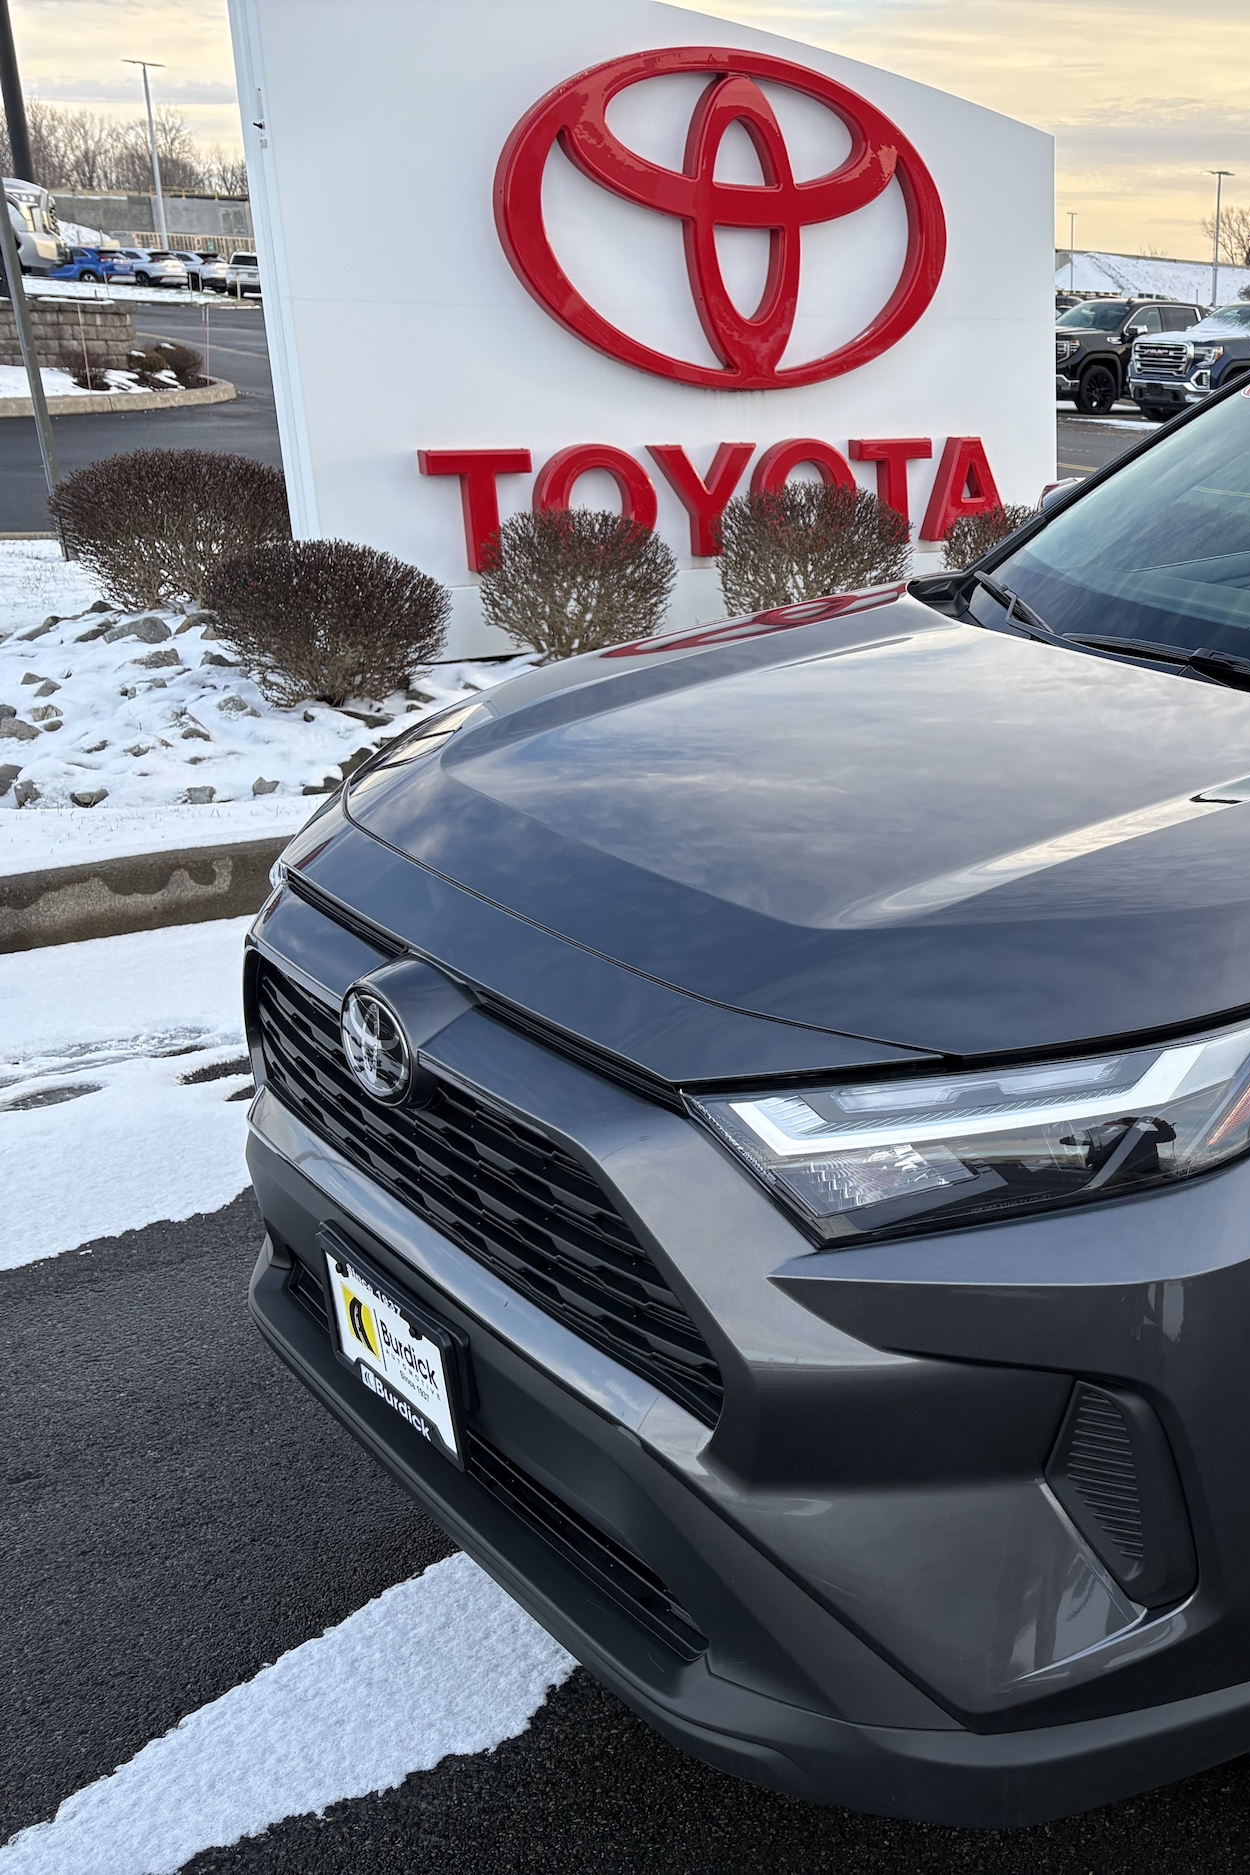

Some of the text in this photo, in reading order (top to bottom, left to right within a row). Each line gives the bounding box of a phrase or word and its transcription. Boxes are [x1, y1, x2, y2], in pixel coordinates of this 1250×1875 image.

[380, 1319, 439, 1390] Burdick
[386, 1349, 441, 1401] AUTOMOTIVE
[375, 1376, 431, 1442] Burdick
